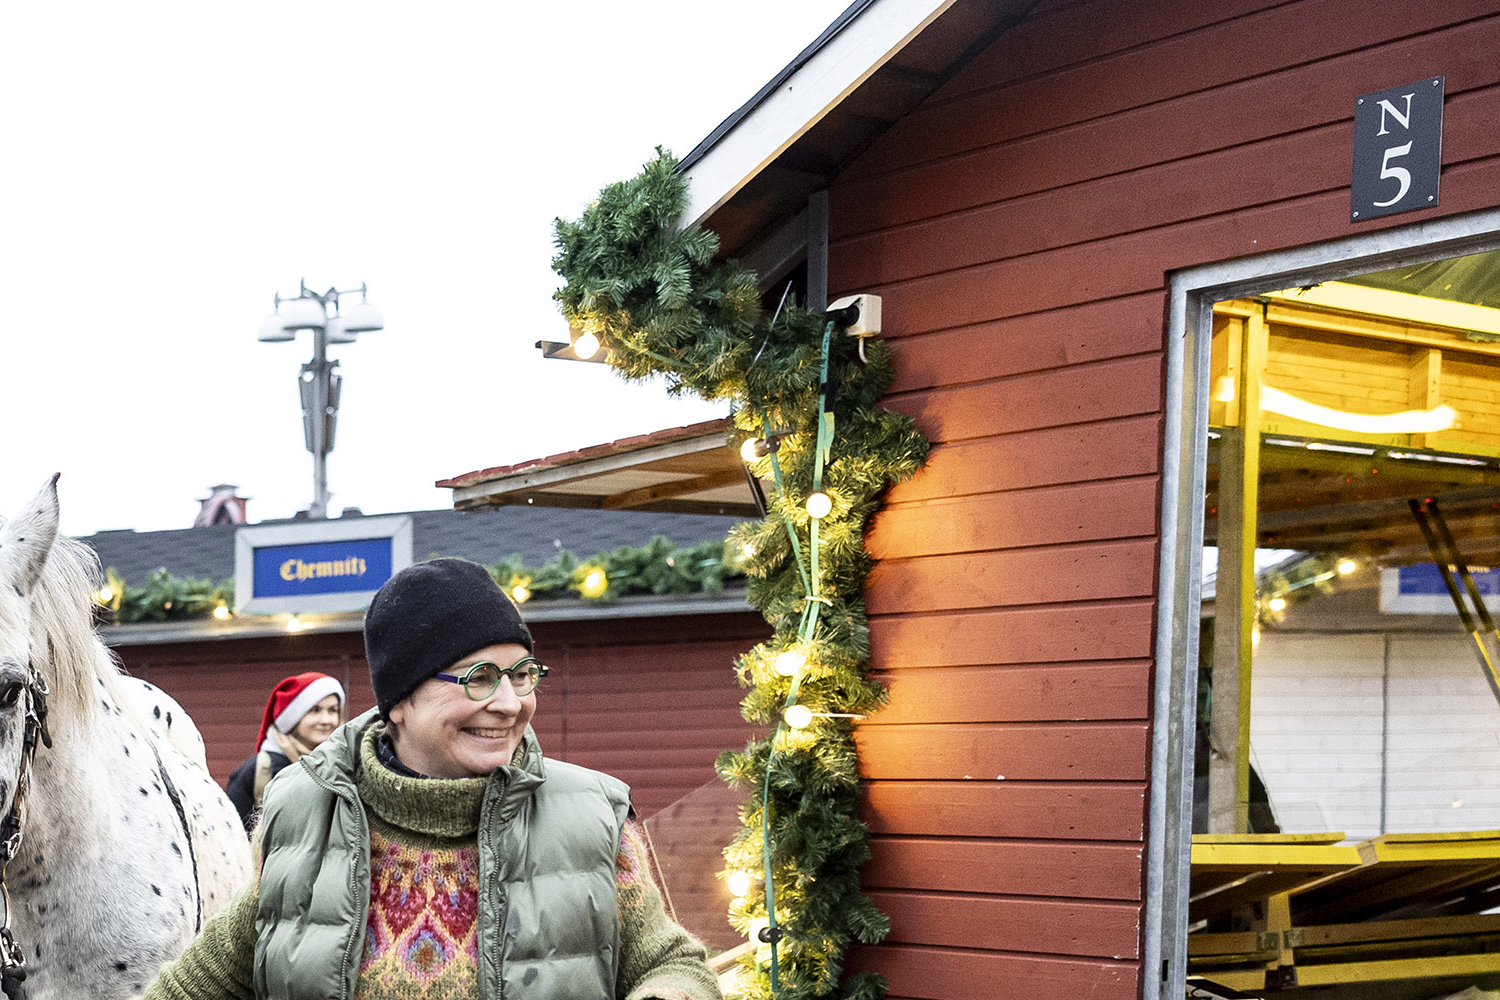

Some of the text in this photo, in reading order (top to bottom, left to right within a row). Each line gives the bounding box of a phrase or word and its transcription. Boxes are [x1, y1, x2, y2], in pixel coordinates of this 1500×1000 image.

[1376, 93, 1415, 137] N
[1373, 140, 1412, 207] 5
[280, 556, 367, 583] Chemnitz
